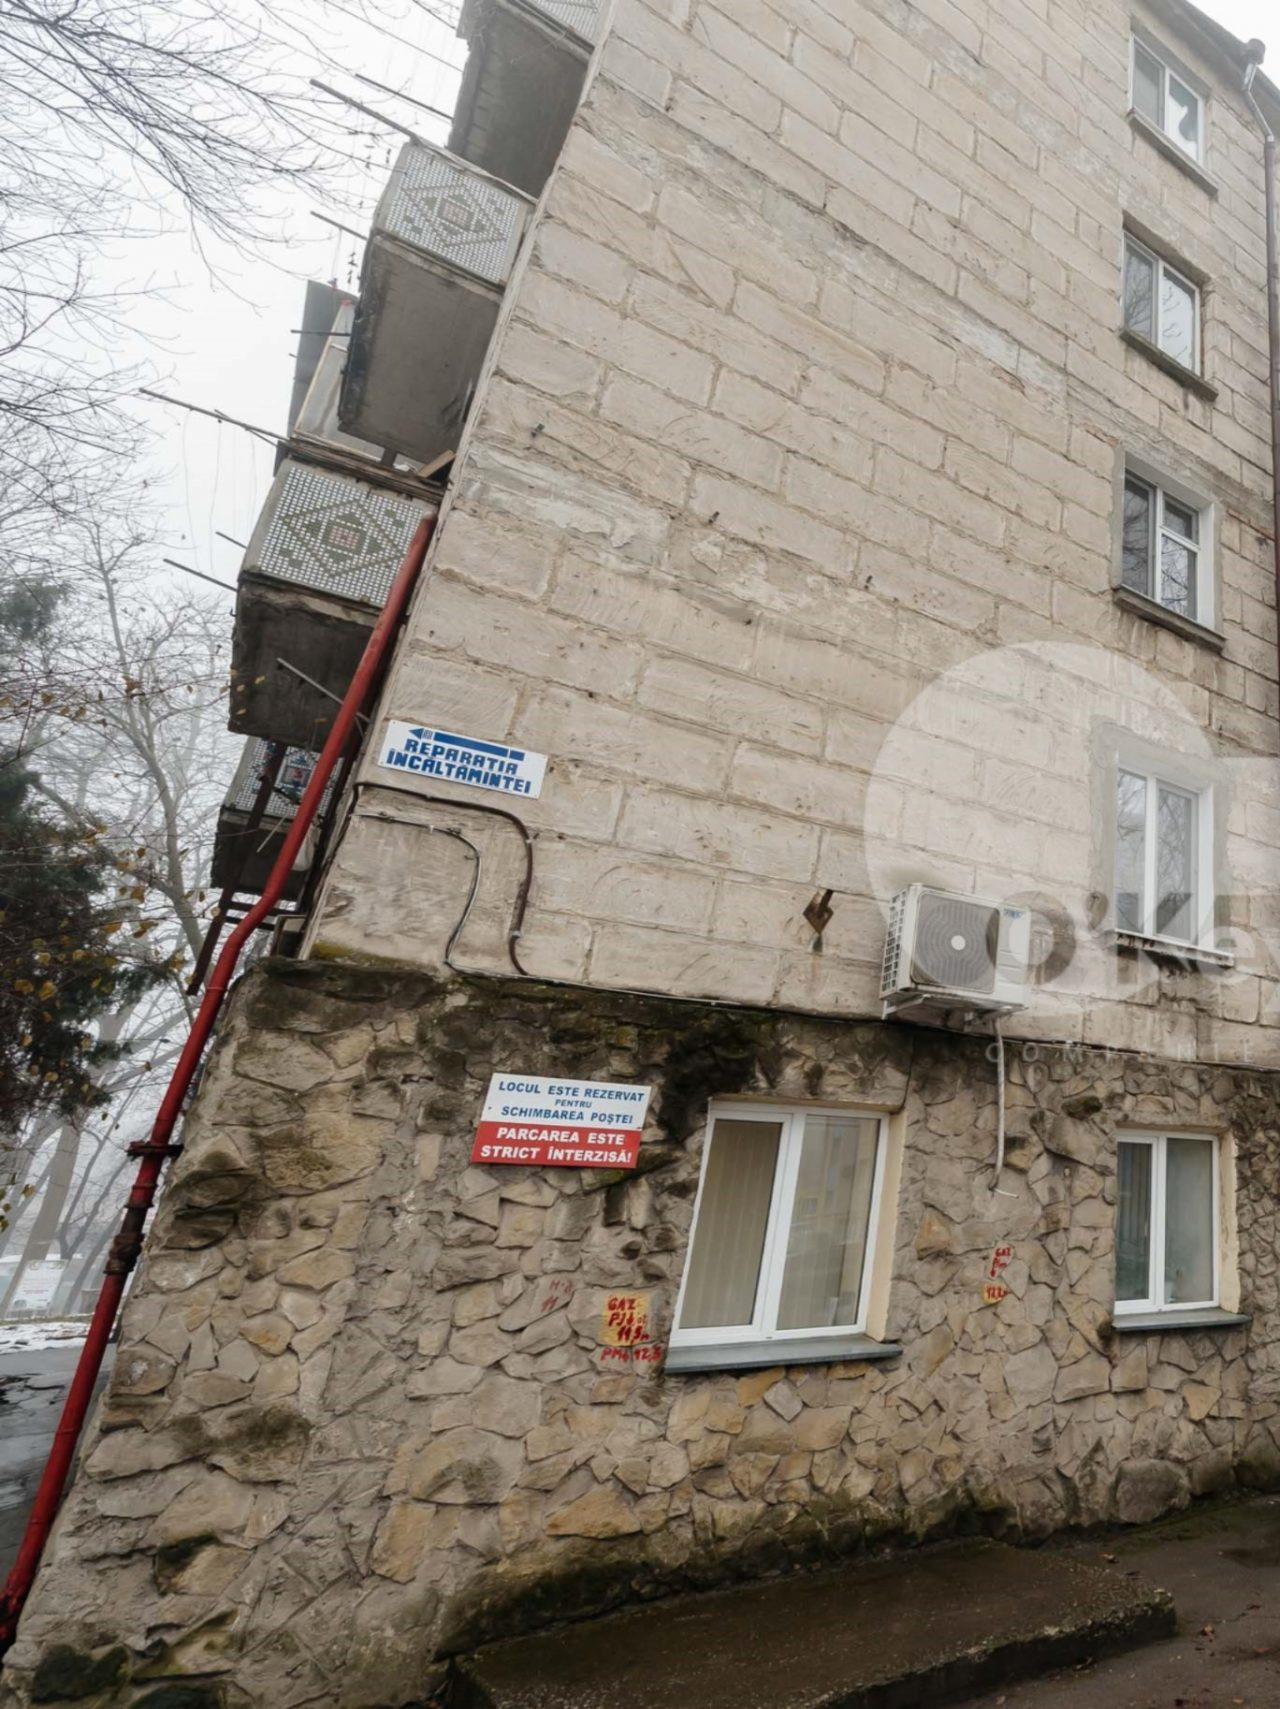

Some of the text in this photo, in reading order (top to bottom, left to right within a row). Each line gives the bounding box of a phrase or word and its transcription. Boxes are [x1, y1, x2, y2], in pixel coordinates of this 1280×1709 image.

[498, 1081, 644, 1102] LOCUL ESTE REZERVAT
[555, 1099, 593, 1109] PENTRU
[501, 1106, 584, 1121] SCHIMBAREA
[496, 1127, 625, 1146] PARCAREA ESTE
[480, 1145, 540, 1160] STRICT
[607, 1297, 636, 1311] GAZ
